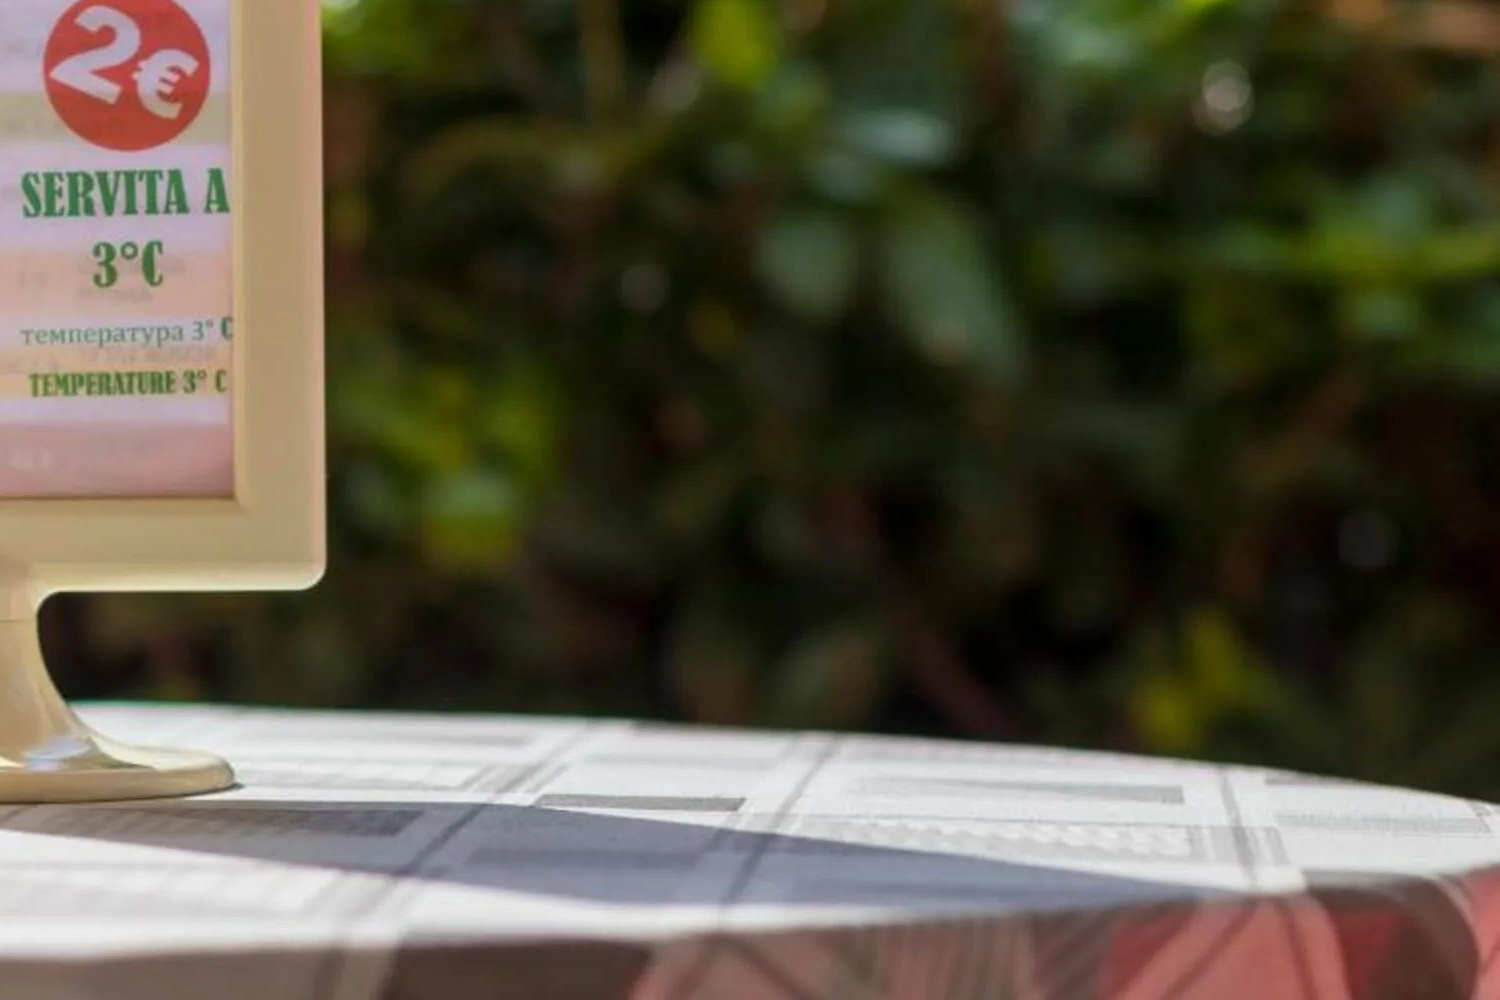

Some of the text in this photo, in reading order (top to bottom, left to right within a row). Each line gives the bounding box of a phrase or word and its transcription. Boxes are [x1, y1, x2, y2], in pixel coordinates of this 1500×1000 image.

[19, 167, 230, 218] SERVITA A
[92, 240, 164, 289] 3°C
[20, 326, 184, 350] температура
[29, 370, 177, 397] TEMPERATURE
[215, 369, 227, 393] C
